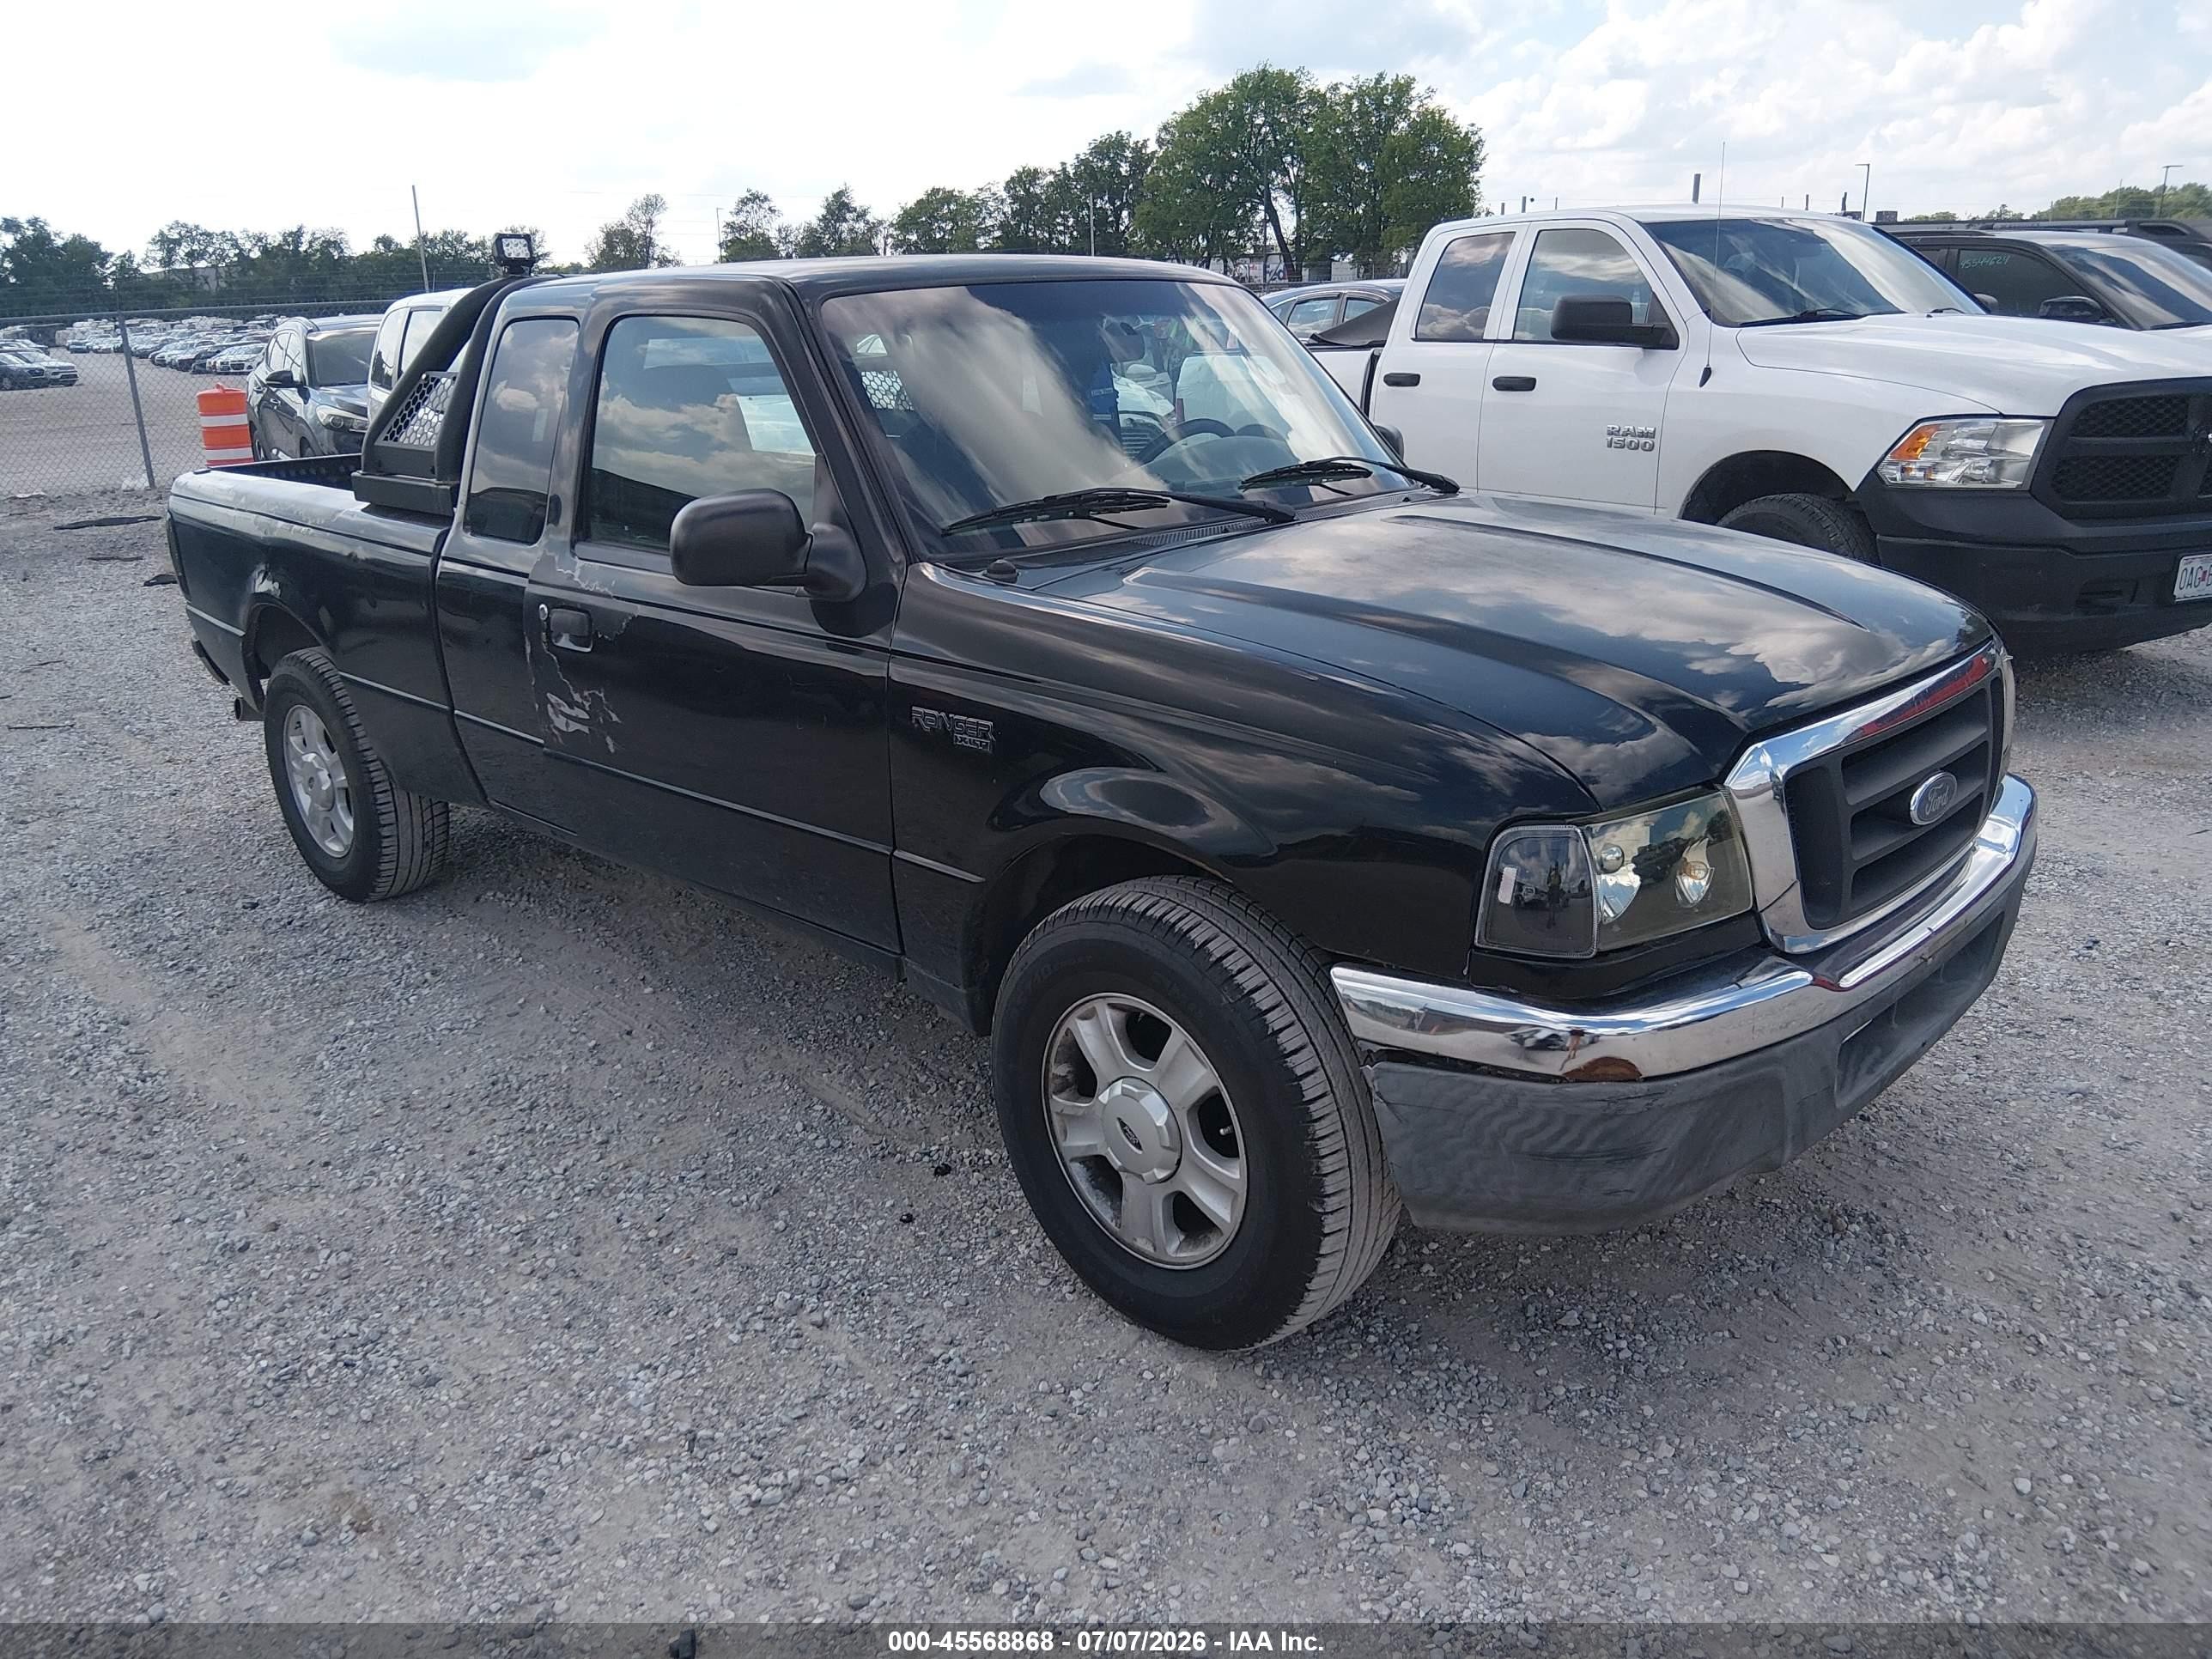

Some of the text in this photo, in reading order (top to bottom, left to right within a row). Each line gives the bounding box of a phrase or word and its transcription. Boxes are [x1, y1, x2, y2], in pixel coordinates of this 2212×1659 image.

[1607, 425, 1656, 439] RAM
[1606, 437, 1655, 452] 1500
[911, 706, 996, 742] RANGER
[954, 734, 992, 751] XLT
[1924, 782, 1950, 816] Ford
